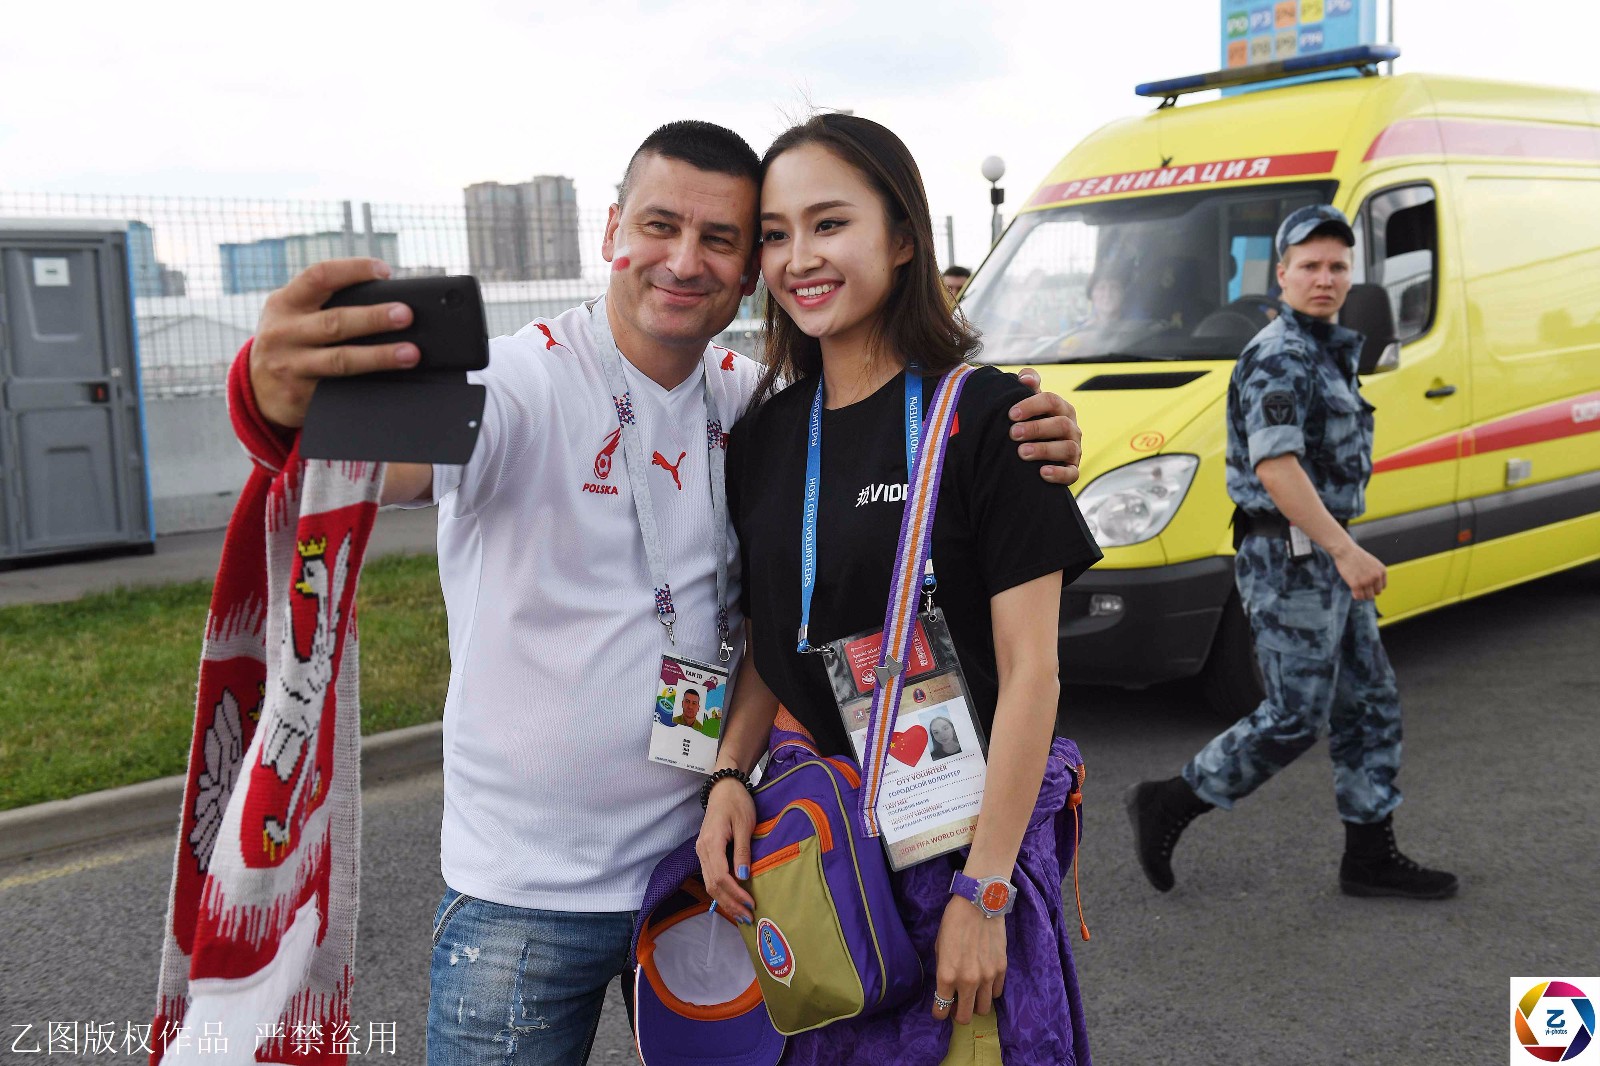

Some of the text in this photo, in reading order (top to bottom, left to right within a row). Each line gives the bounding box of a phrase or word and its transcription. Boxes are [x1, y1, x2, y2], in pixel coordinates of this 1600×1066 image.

[1062, 157, 1271, 199] РЕАНИМАЦИЯ
[910, 396, 919, 454] ВОЛОНТЕРЫ
[582, 483, 619, 495] POLSKA
[804, 477, 816, 588] HOST CITY VOLUNTEERS
[911, 765, 948, 781] VOLUNTEER
[916, 841, 930, 850] FIFA
[930, 832, 955, 843] WORLD
[955, 827, 969, 836] CUP
